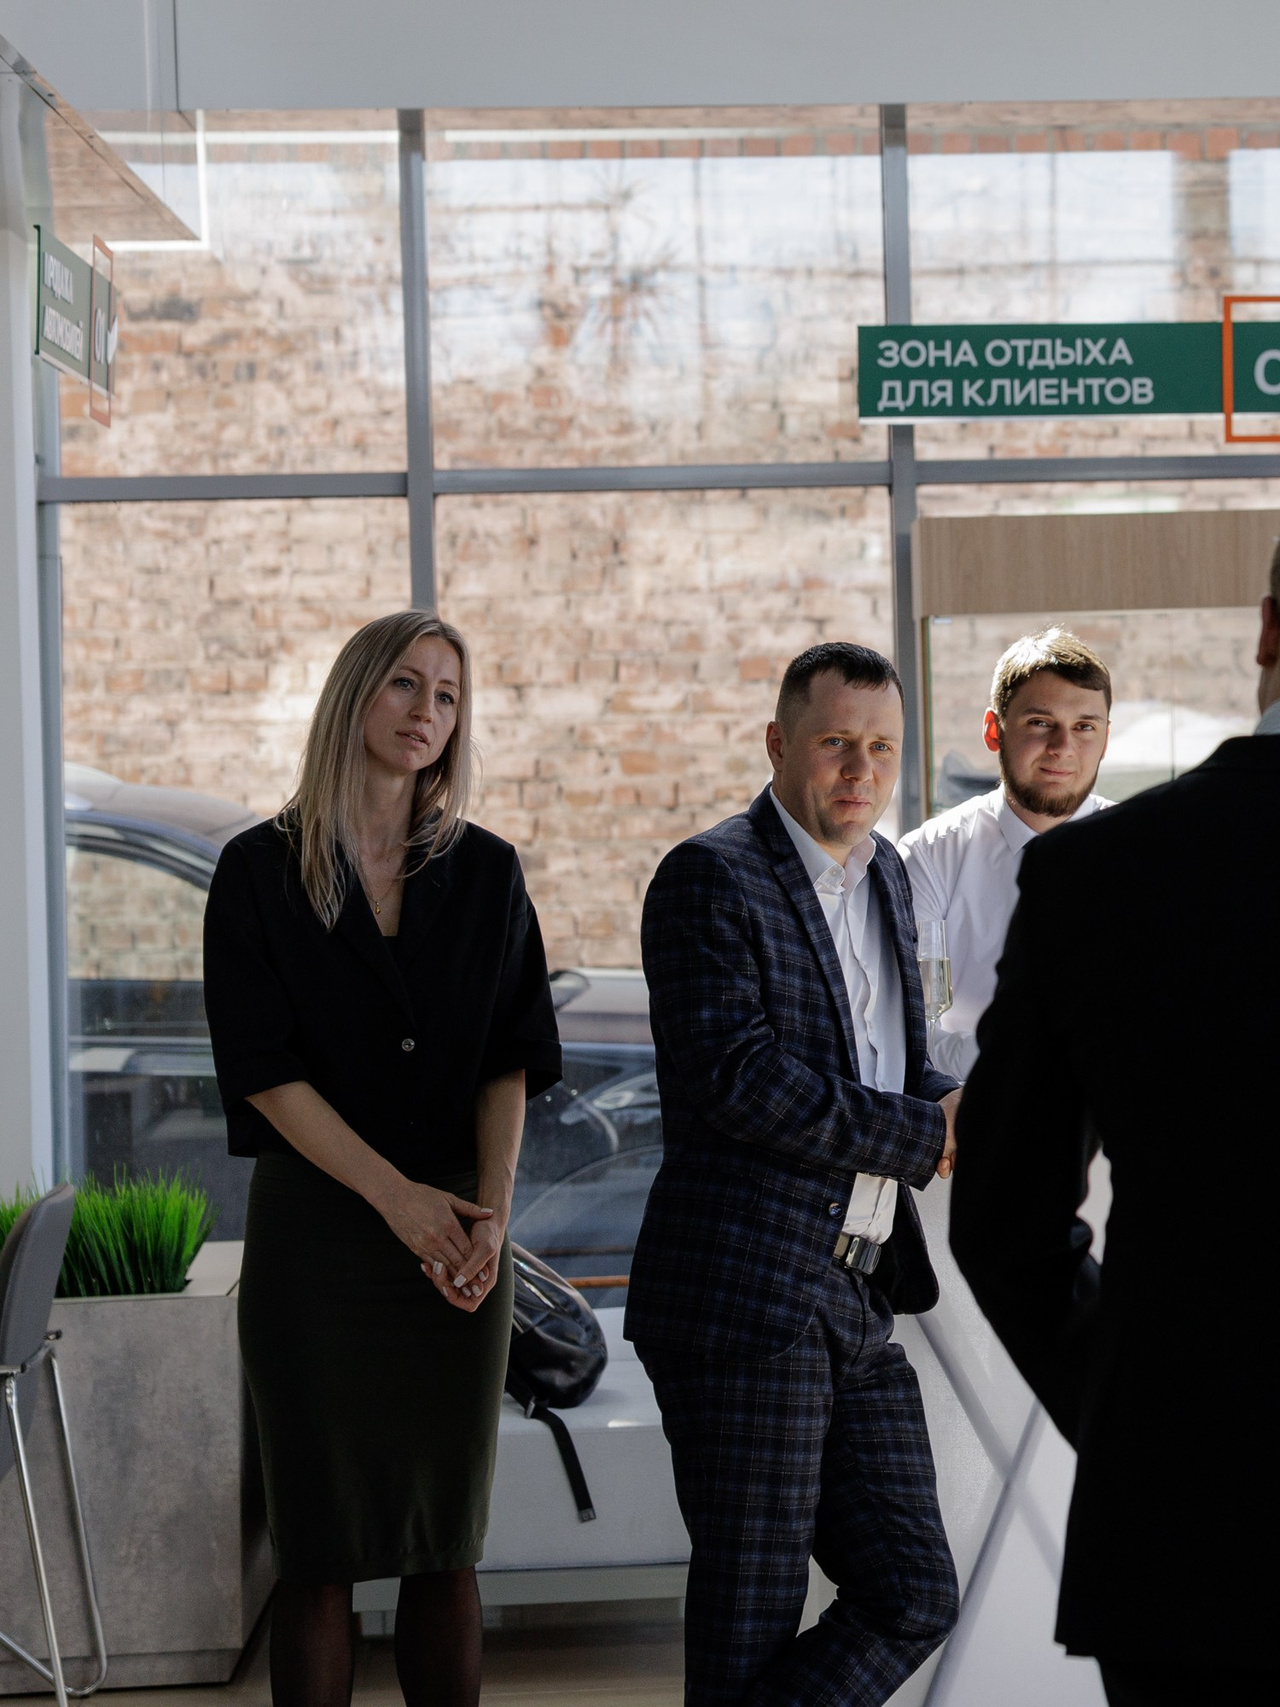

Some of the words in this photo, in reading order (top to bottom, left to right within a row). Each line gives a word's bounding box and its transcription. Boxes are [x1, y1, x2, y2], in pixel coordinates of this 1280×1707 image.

[877, 339, 979, 368] ЗОНА
[984, 337, 1134, 371] ОТДЫХА
[877, 379, 954, 412] ДЛЯ
[962, 377, 1155, 406] КЛИЕНТОВ
